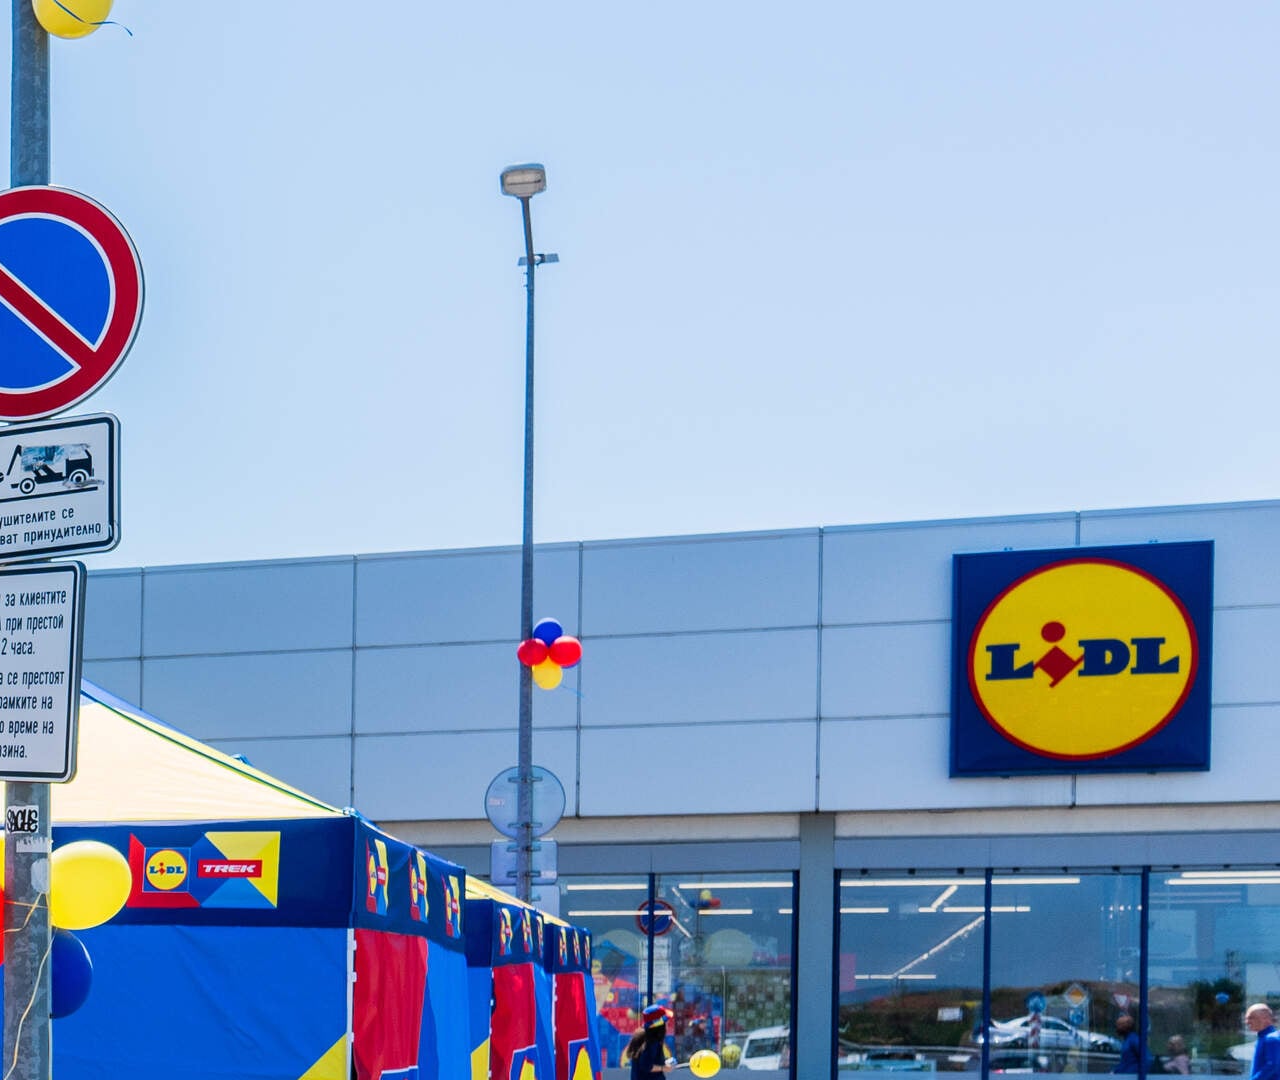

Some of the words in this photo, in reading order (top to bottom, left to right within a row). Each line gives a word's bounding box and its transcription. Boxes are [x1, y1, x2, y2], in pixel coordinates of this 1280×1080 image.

[62, 508, 74, 519] се
[24, 523, 101, 544] принудително
[5, 594, 15, 607] за
[20, 590, 66, 606] клиентите
[6, 617, 22, 635] при
[27, 614, 64, 635] престой
[1, 638, 7, 655] 2
[11, 641, 35, 655] часа.
[7, 672, 18, 684] се
[22, 670, 65, 689] престоят
[42, 696, 53, 708] на
[9, 720, 38, 738] време
[42, 721, 54, 734] на
[201, 864, 256, 874] TREK
